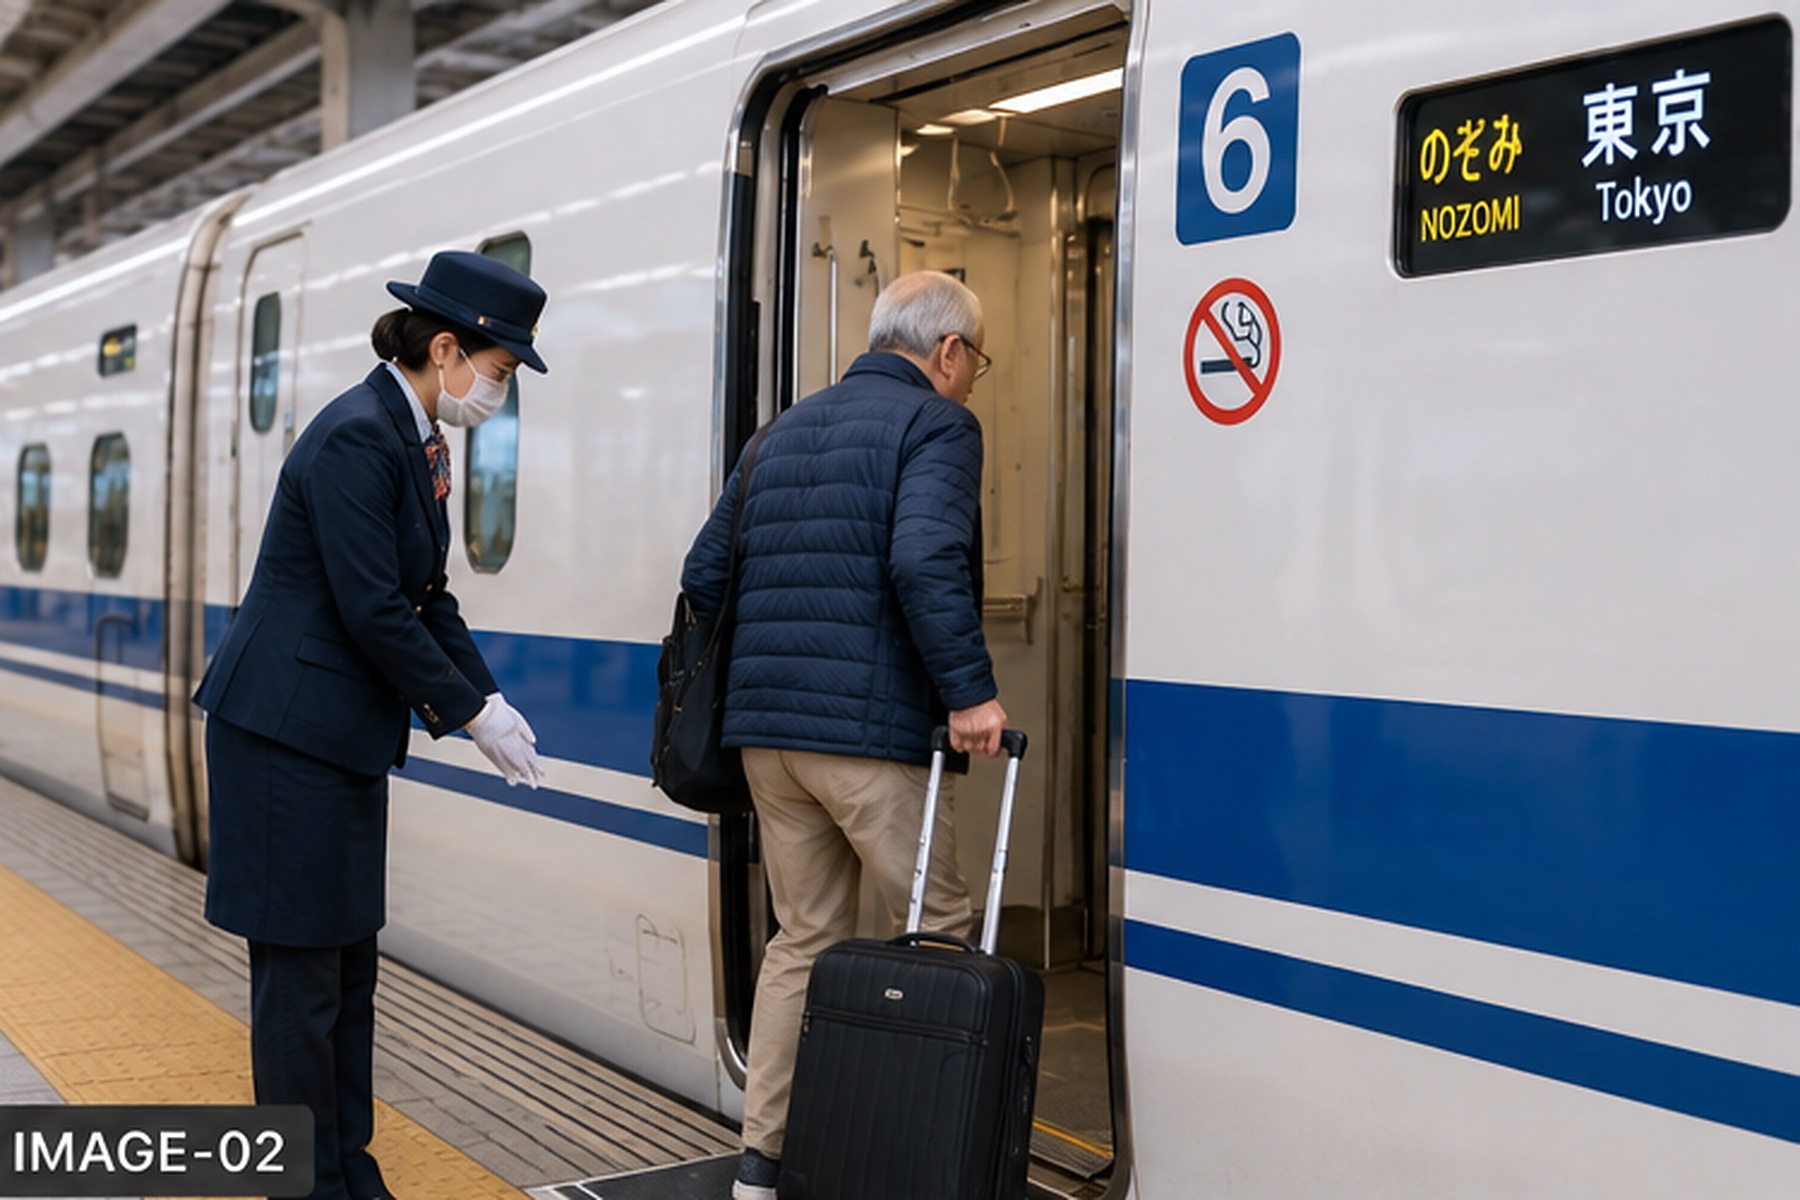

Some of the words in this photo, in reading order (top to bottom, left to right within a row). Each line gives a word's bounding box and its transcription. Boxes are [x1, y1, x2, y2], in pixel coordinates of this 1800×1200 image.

[1202, 66, 1271, 214] 6
[1581, 68, 1711, 167] 東京
[1420, 194, 1521, 242] NOZOMI
[1596, 175, 1692, 225] Tokyo
